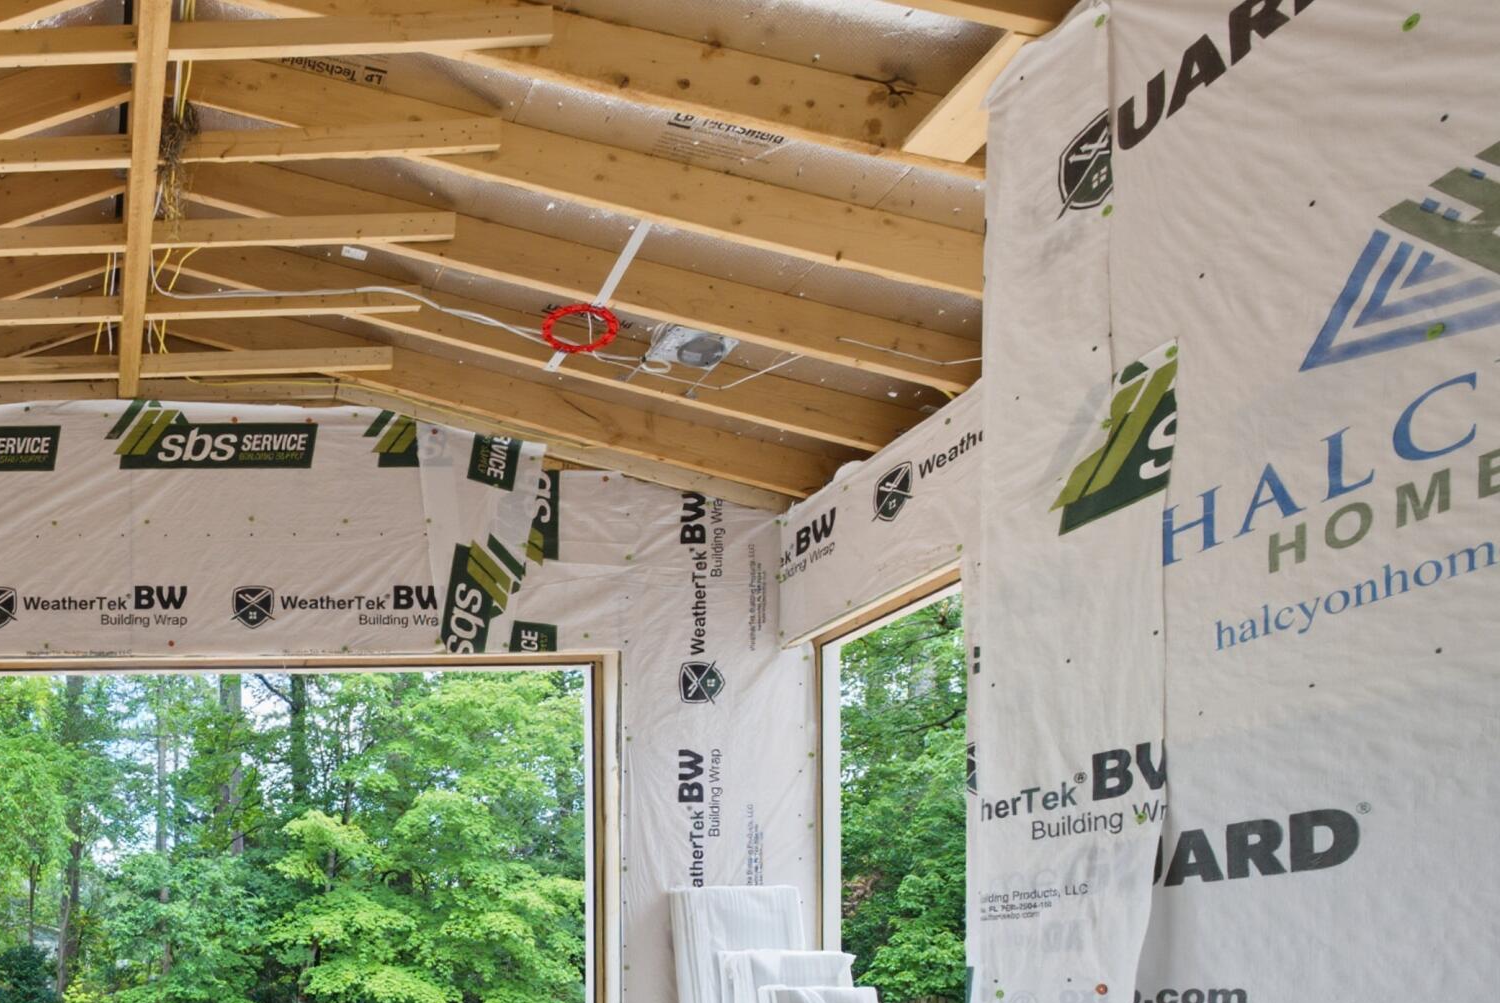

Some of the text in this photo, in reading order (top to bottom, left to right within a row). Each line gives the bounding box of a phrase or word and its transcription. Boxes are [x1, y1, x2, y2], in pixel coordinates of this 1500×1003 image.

[1118, 0, 1315, 150] UAR
[157, 427, 309, 463] sbs SERVICE
[918, 430, 983, 479] Weath
[1161, 372, 1478, 568] HALC
[680, 492, 707, 545] BW
[796, 507, 837, 557] BW
[710, 526, 726, 578] Building
[100, 613, 188, 628] Building Wrap
[134, 585, 188, 610] BW
[359, 613, 409, 628] Building
[678, 748, 705, 803] BW
[708, 748, 724, 838] Building Wrap
[1031, 811, 1124, 841] Building
[1064, 883, 1090, 896] LLC
